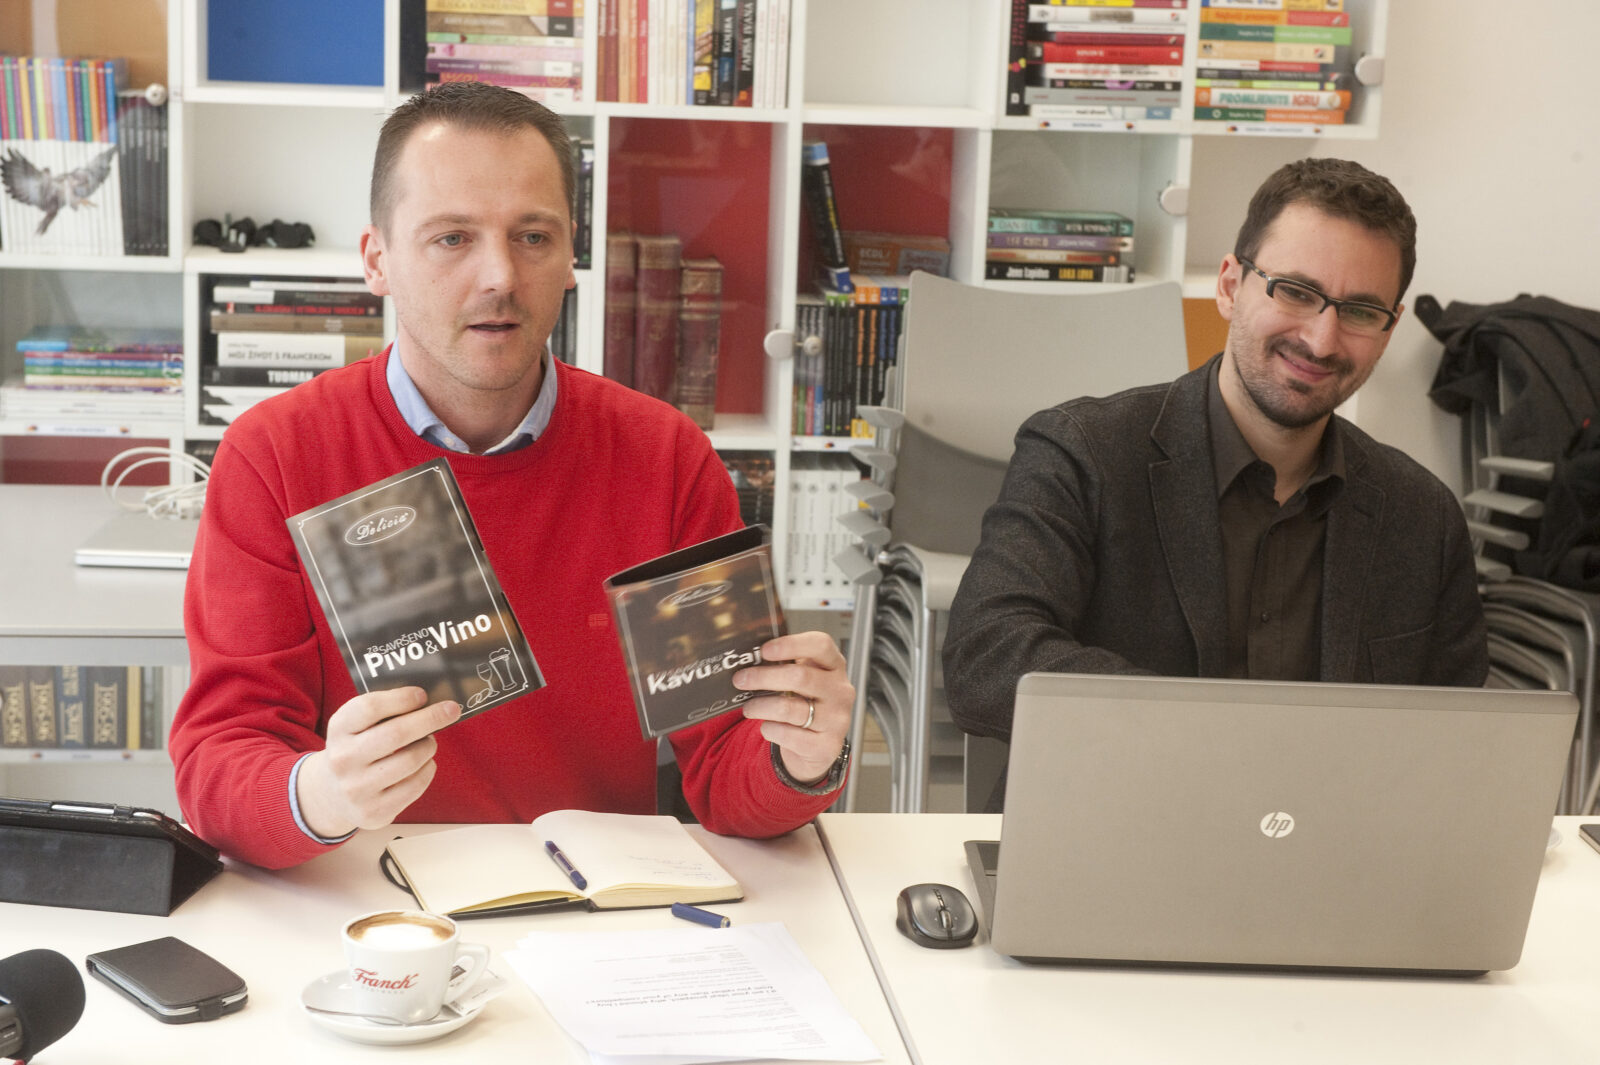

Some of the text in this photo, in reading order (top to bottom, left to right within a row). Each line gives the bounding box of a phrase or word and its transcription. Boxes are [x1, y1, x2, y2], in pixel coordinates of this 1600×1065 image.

[742, 2, 754, 35] IVANA
[1292, 94, 1320, 107] IGRU
[227, 351, 246, 359] MOJ
[247, 350, 273, 360] ŽIVOT
[363, 613, 492, 678] Pivo & Vino
[646, 664, 712, 695] Kavu
[721, 646, 762, 669] Čaj
[1263, 812, 1292, 838] hp
[352, 968, 420, 990] Franck
